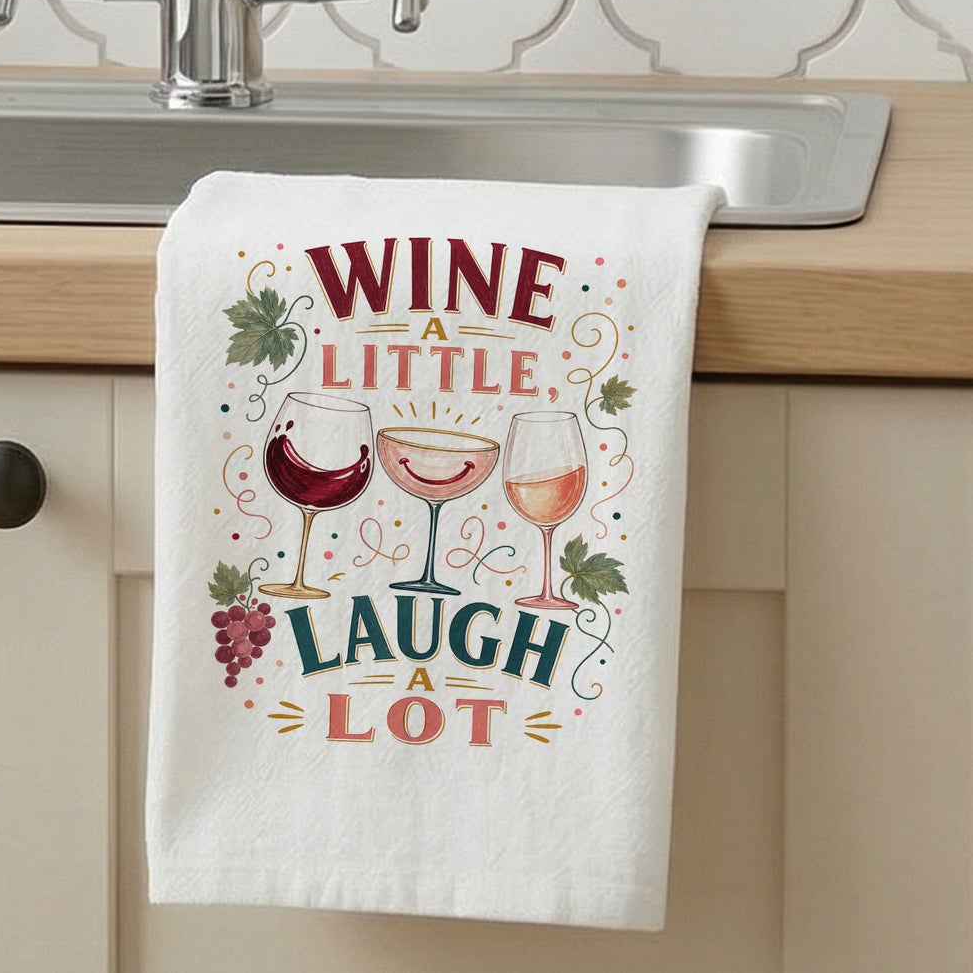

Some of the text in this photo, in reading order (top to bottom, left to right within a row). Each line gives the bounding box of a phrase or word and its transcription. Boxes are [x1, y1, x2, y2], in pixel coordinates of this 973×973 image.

[305, 236, 567, 331] WINE
[421, 317, 448, 341] A
[320, 344, 559, 403] LITTLE,
[284, 594, 570, 689] LAUGH
[406, 667, 434, 691] A
[326, 693, 507, 747] LOT
